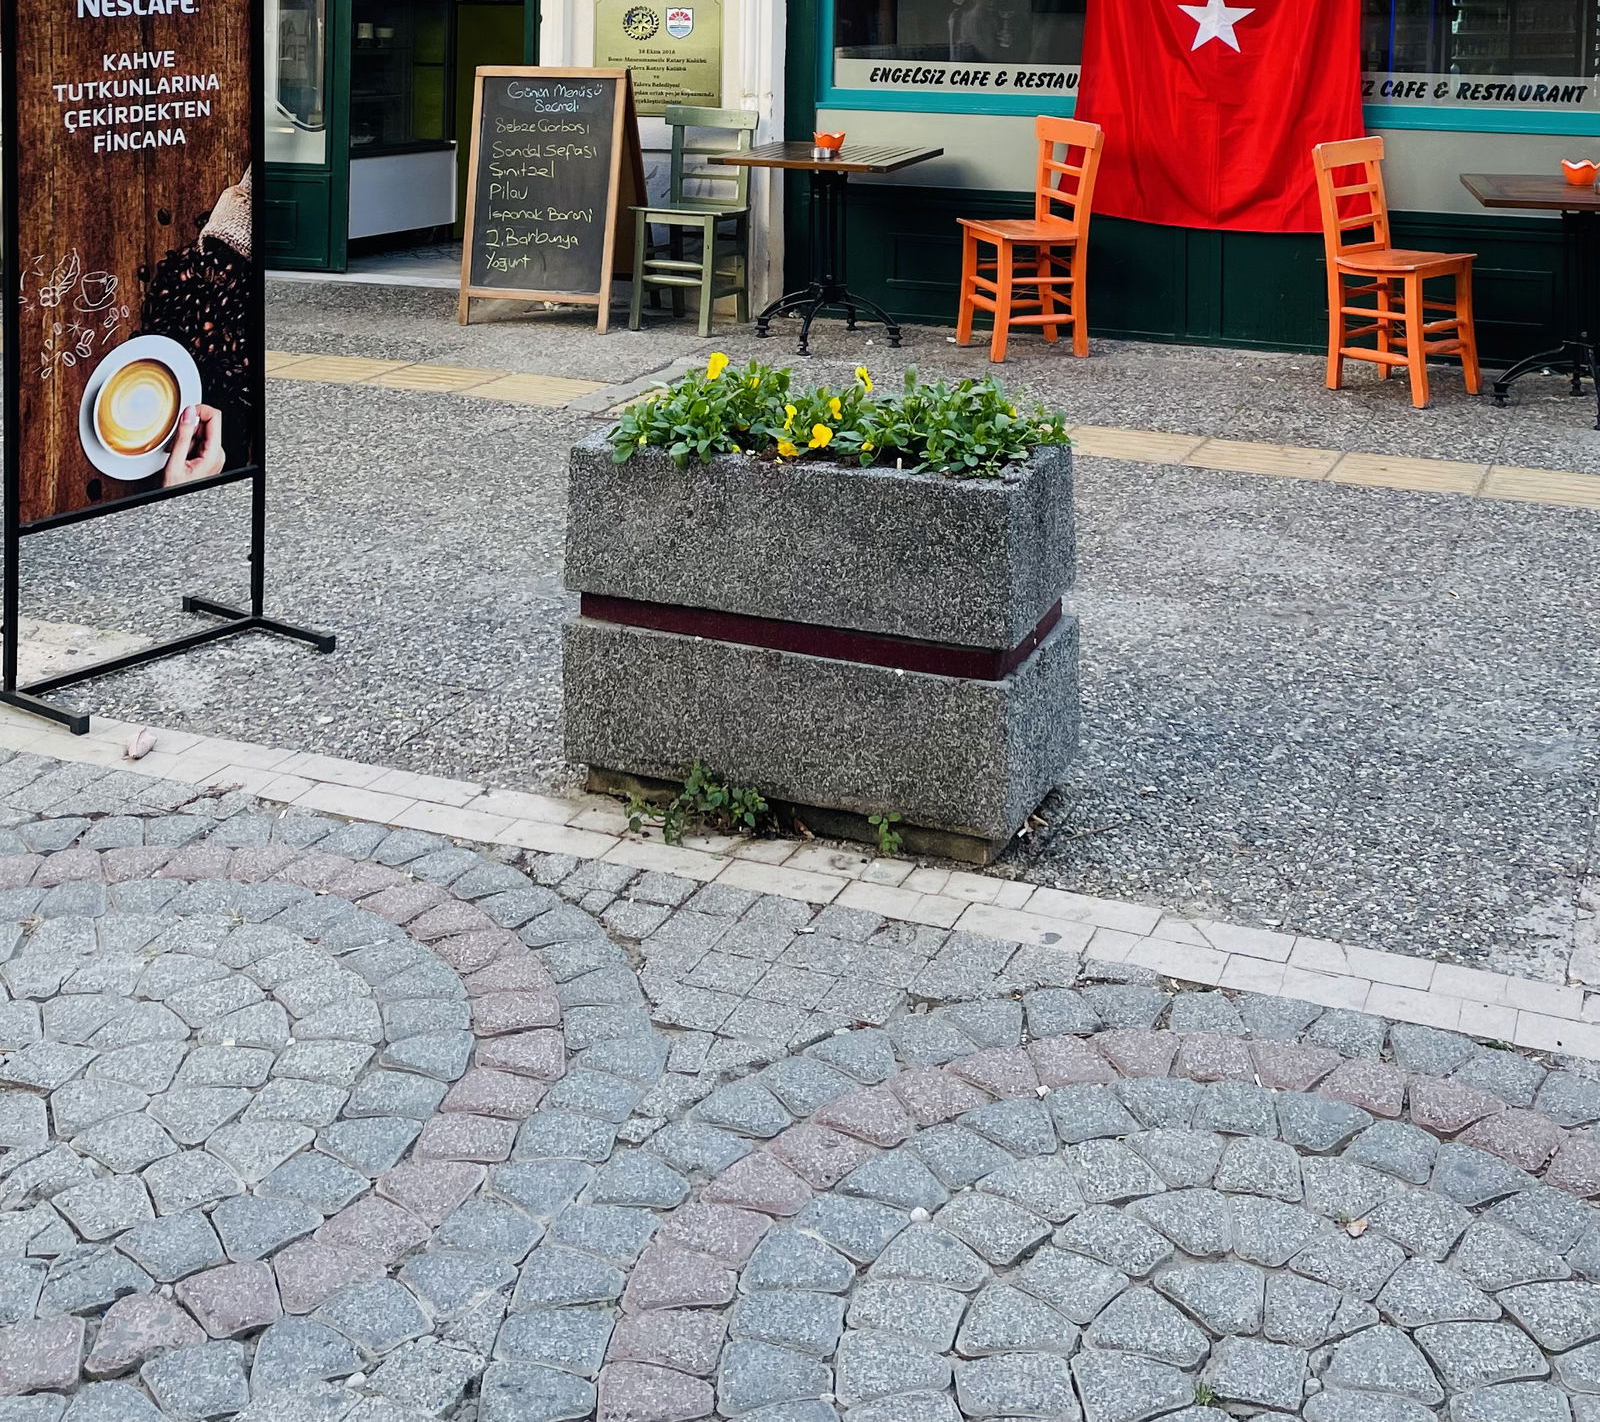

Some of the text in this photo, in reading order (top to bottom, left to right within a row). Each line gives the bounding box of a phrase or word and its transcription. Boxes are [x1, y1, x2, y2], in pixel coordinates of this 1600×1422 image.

[103, 50, 176, 72] KAHVE
[52, 73, 220, 103] TUTKUNLARINA
[950, 69, 988, 87] CAFE
[995, 71, 1008, 86] &
[1013, 71, 1081, 89] RESTAU
[1380, 80, 1428, 99] CAFE
[1433, 81, 1449, 99] &
[1456, 82, 1588, 103] RESTAURANT
[64, 100, 211, 133] ÇEKİRDEKTEN
[93, 128, 187, 154] FİNCANA
